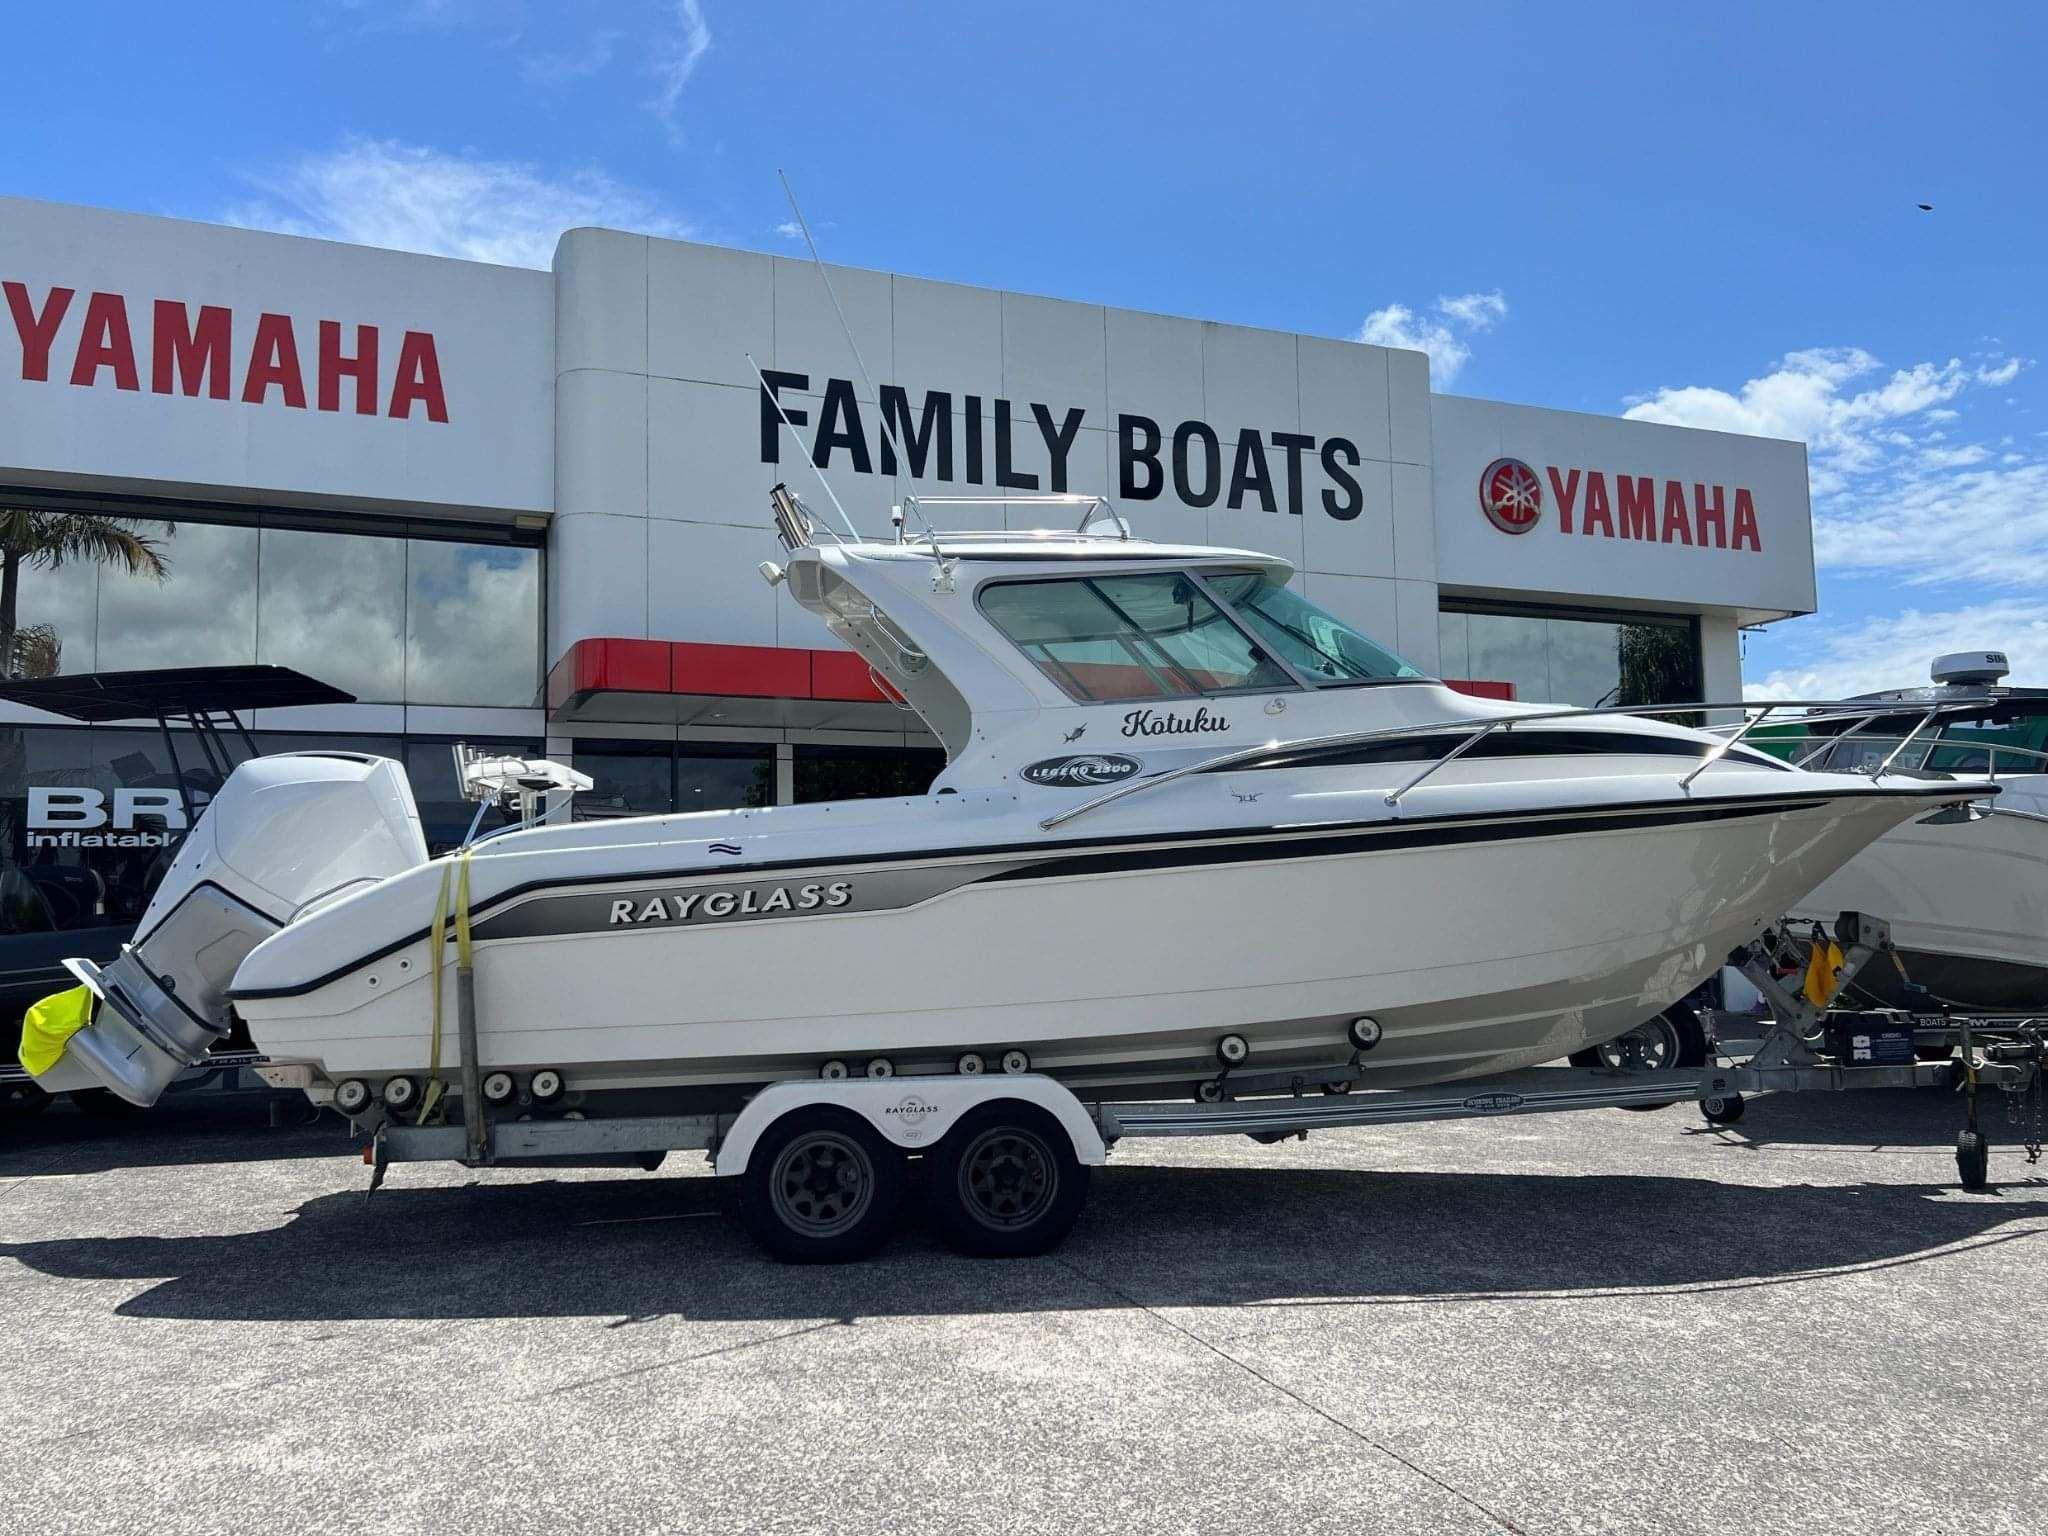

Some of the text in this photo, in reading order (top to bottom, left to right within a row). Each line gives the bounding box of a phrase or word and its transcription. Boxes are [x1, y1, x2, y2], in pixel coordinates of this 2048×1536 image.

[1, 281, 449, 424] YAMAHA
[760, 368, 1364, 522] FAMILY BOATS
[1546, 465, 1762, 553] YAMAHA
[1121, 707, 1231, 738] Kōtuku
[1032, 766, 1089, 778] LEGEND
[609, 881, 854, 924] RAYGLASS
[885, 1105, 939, 1114] RAYGLASS
